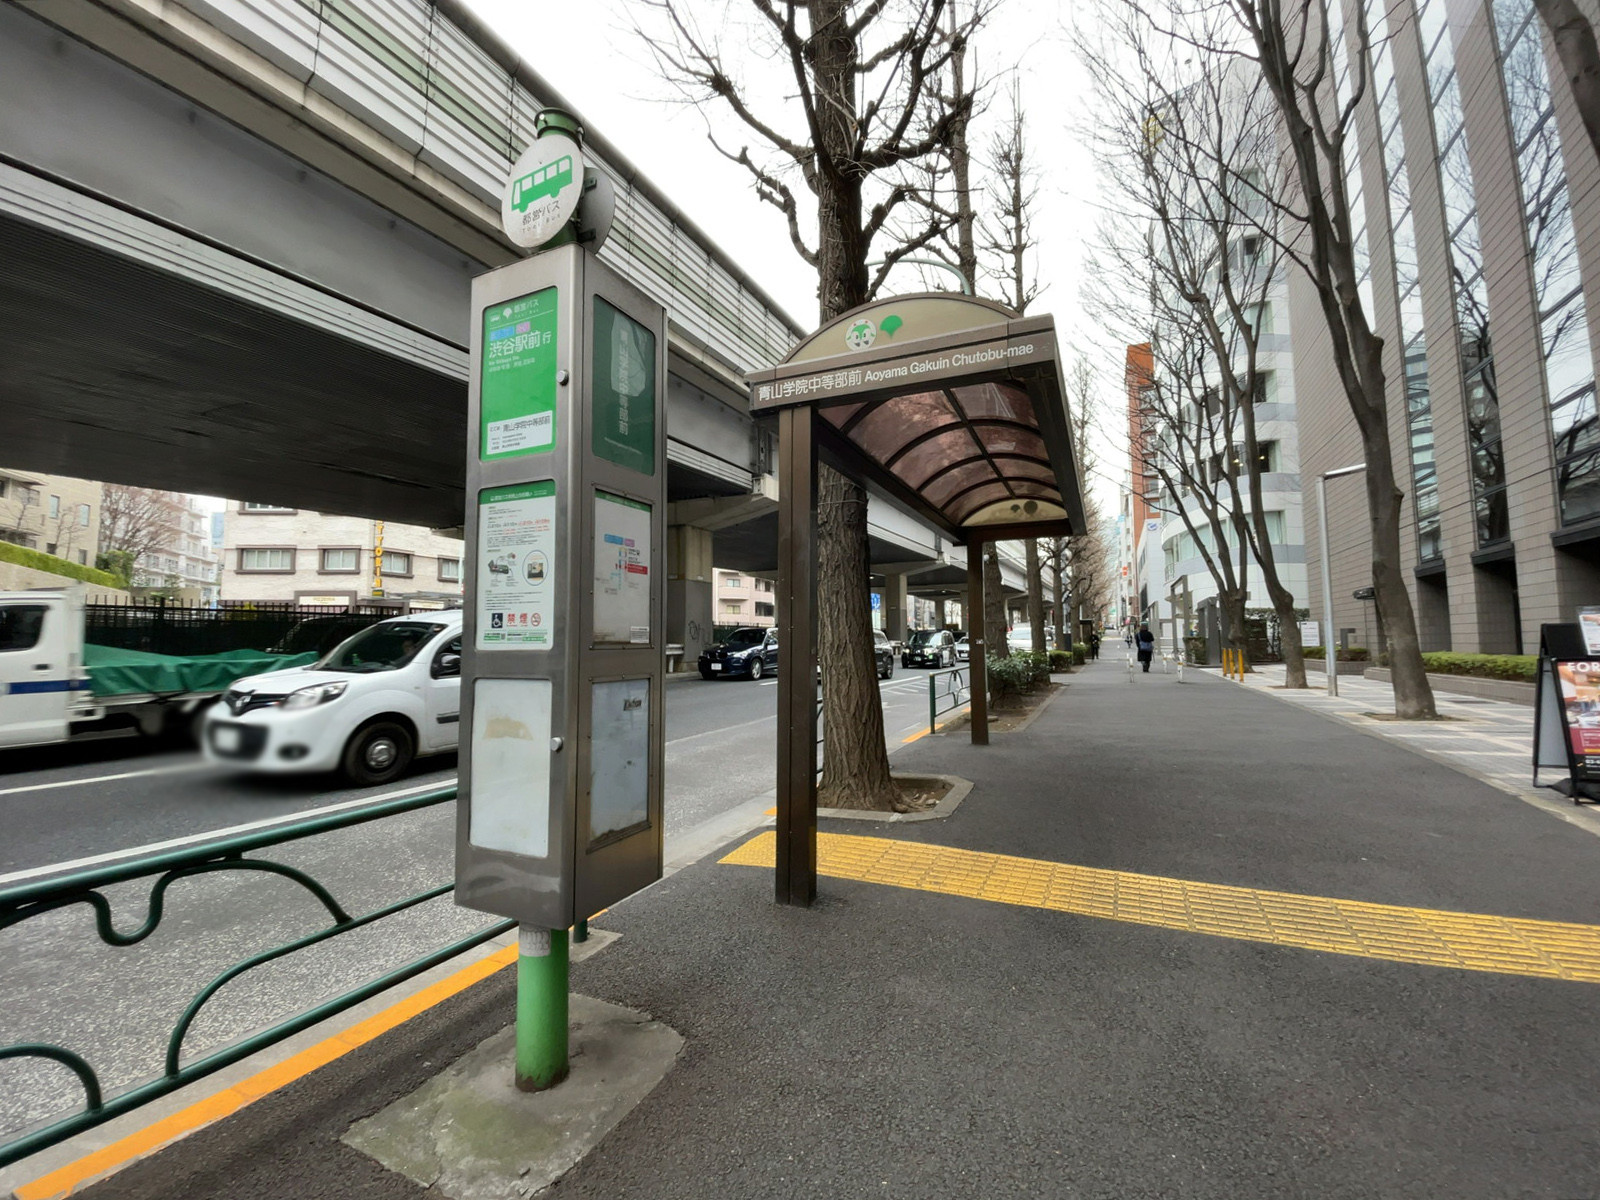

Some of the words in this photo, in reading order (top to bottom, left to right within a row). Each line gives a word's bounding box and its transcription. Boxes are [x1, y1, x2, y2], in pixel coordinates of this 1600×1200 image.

[522, 200, 560, 226] 都営バス
[758, 370, 862, 402] 青山学院中等部前
[864, 367, 908, 383] Aoyama
[910, 359, 950, 375] Gakuin
[952, 343, 1034, 367] Chutobu-mae
